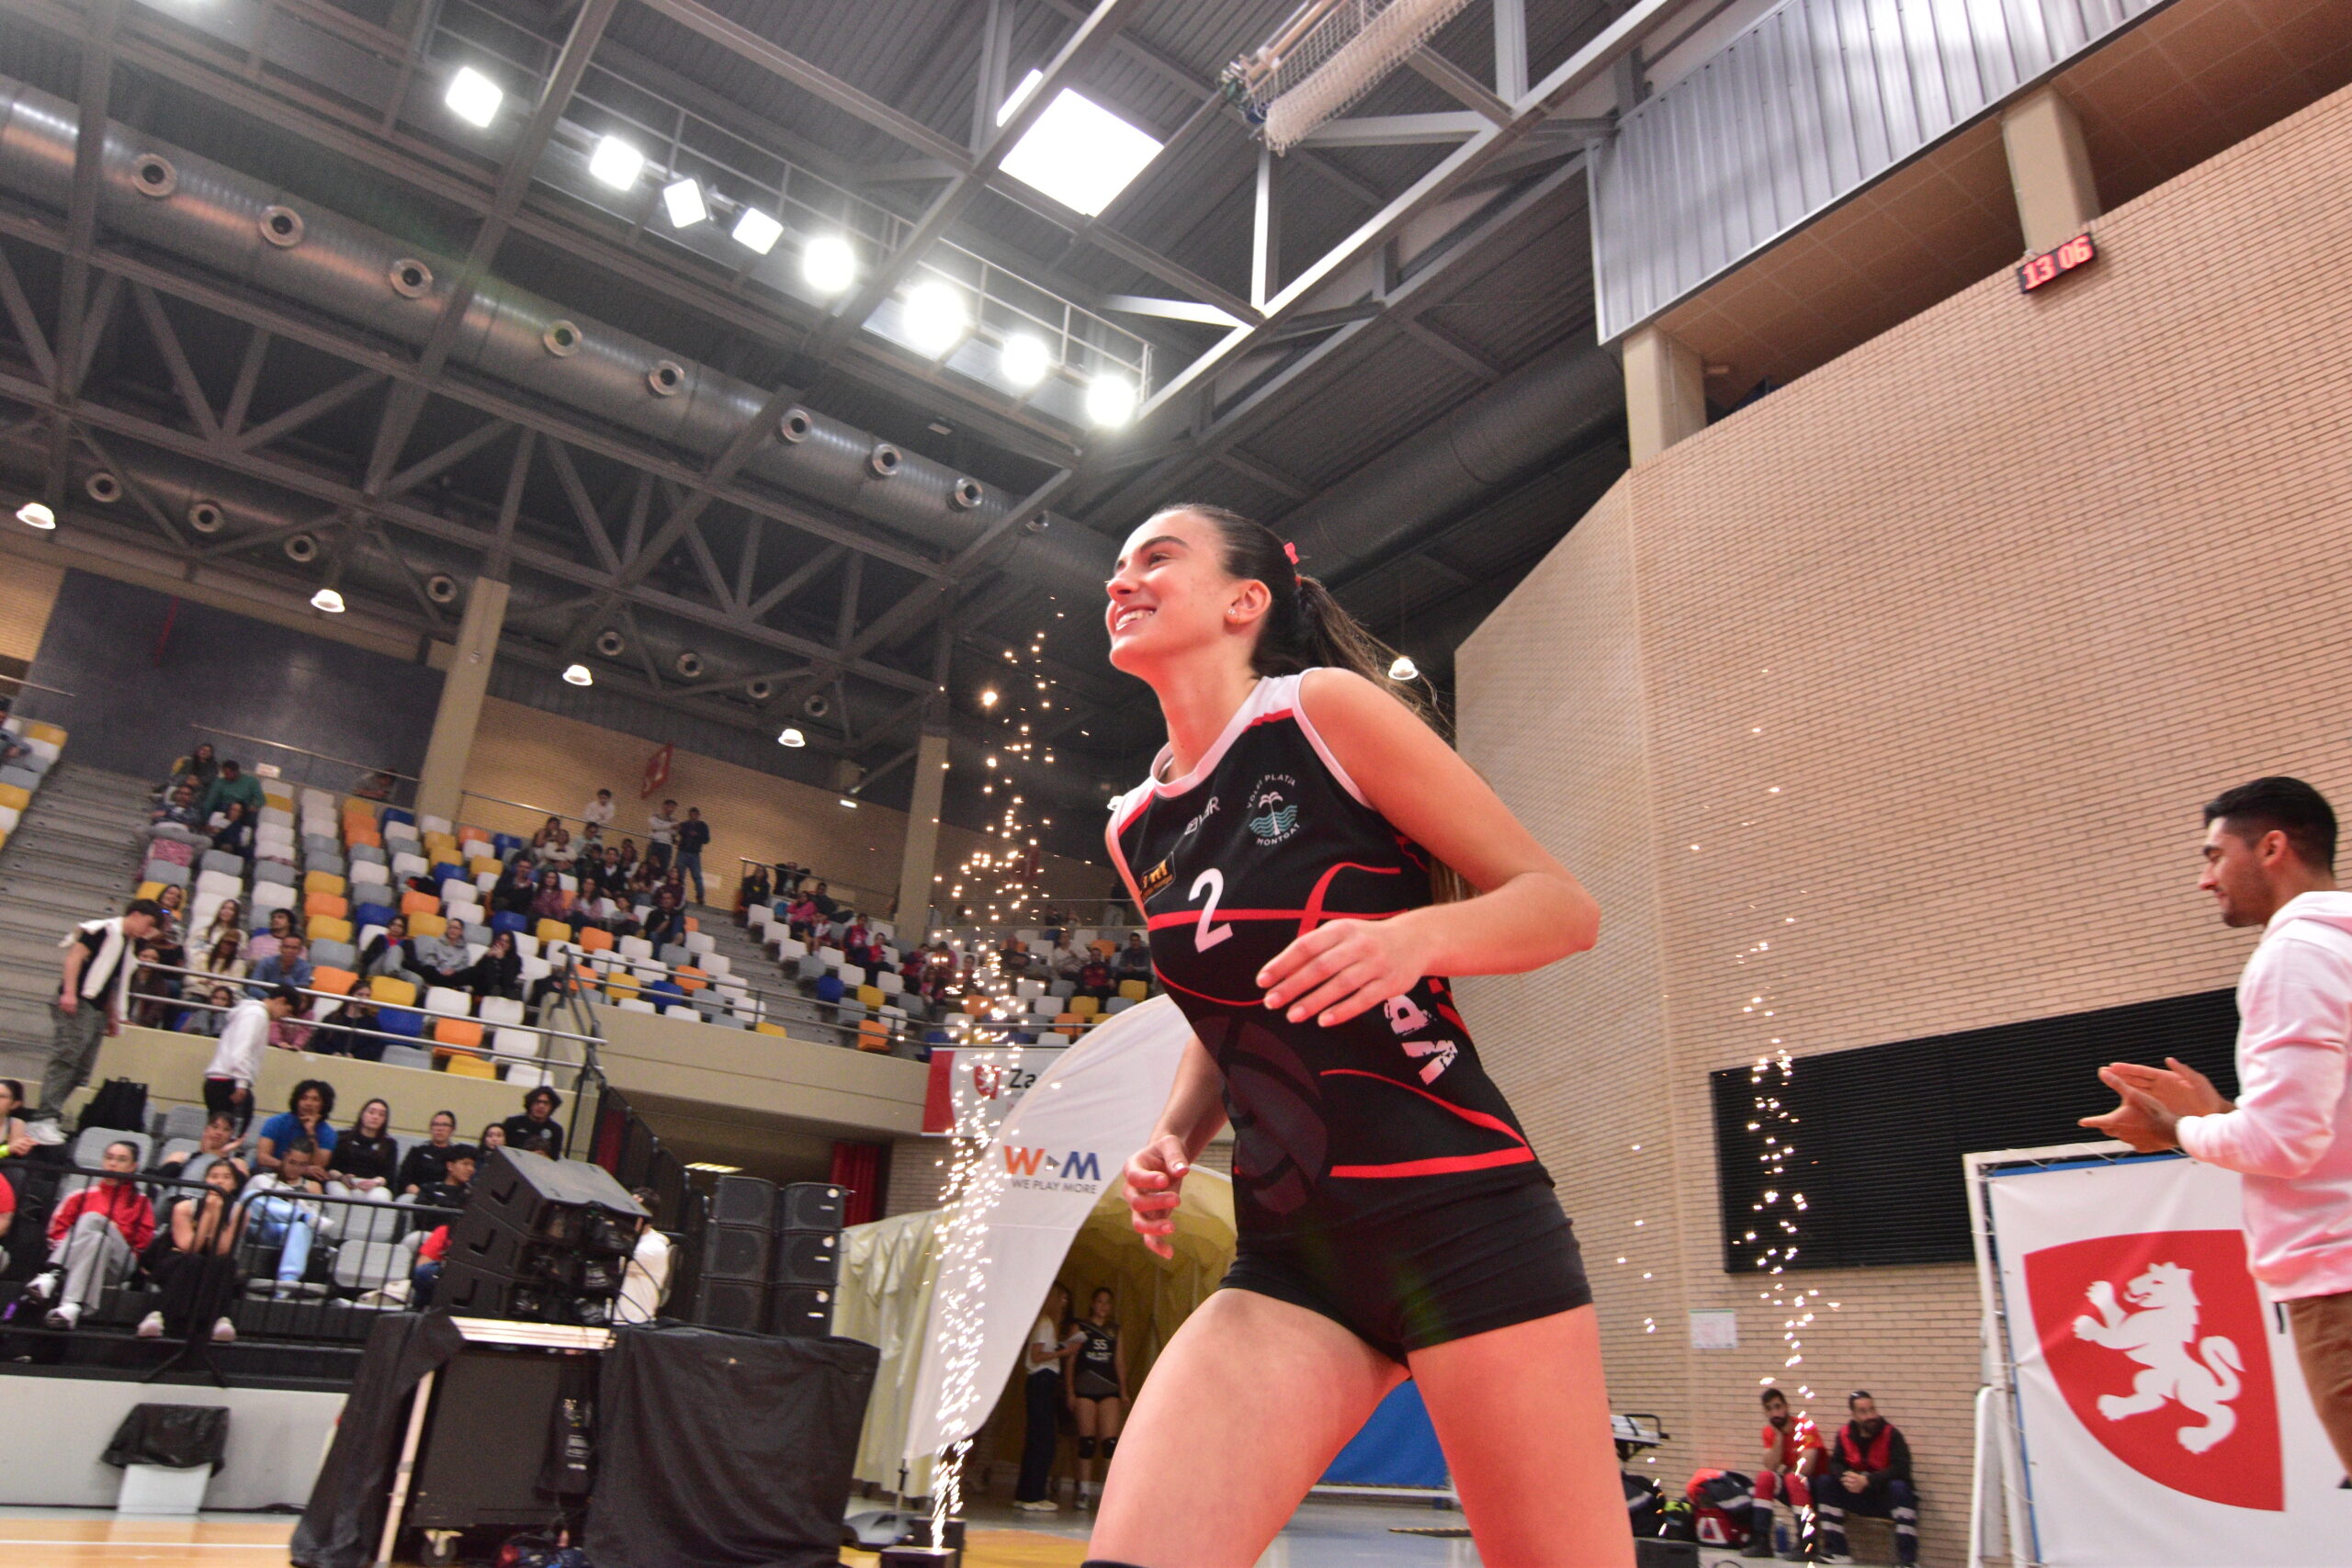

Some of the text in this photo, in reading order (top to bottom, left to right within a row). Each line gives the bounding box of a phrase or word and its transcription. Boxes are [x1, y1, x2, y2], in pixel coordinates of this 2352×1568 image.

[2022, 235, 2094, 289] 13 06
[1188, 867, 1233, 953] 2
[1009, 1067, 1041, 1089] Za
[1011, 1179, 1097, 1195] WE PLAY MORE
